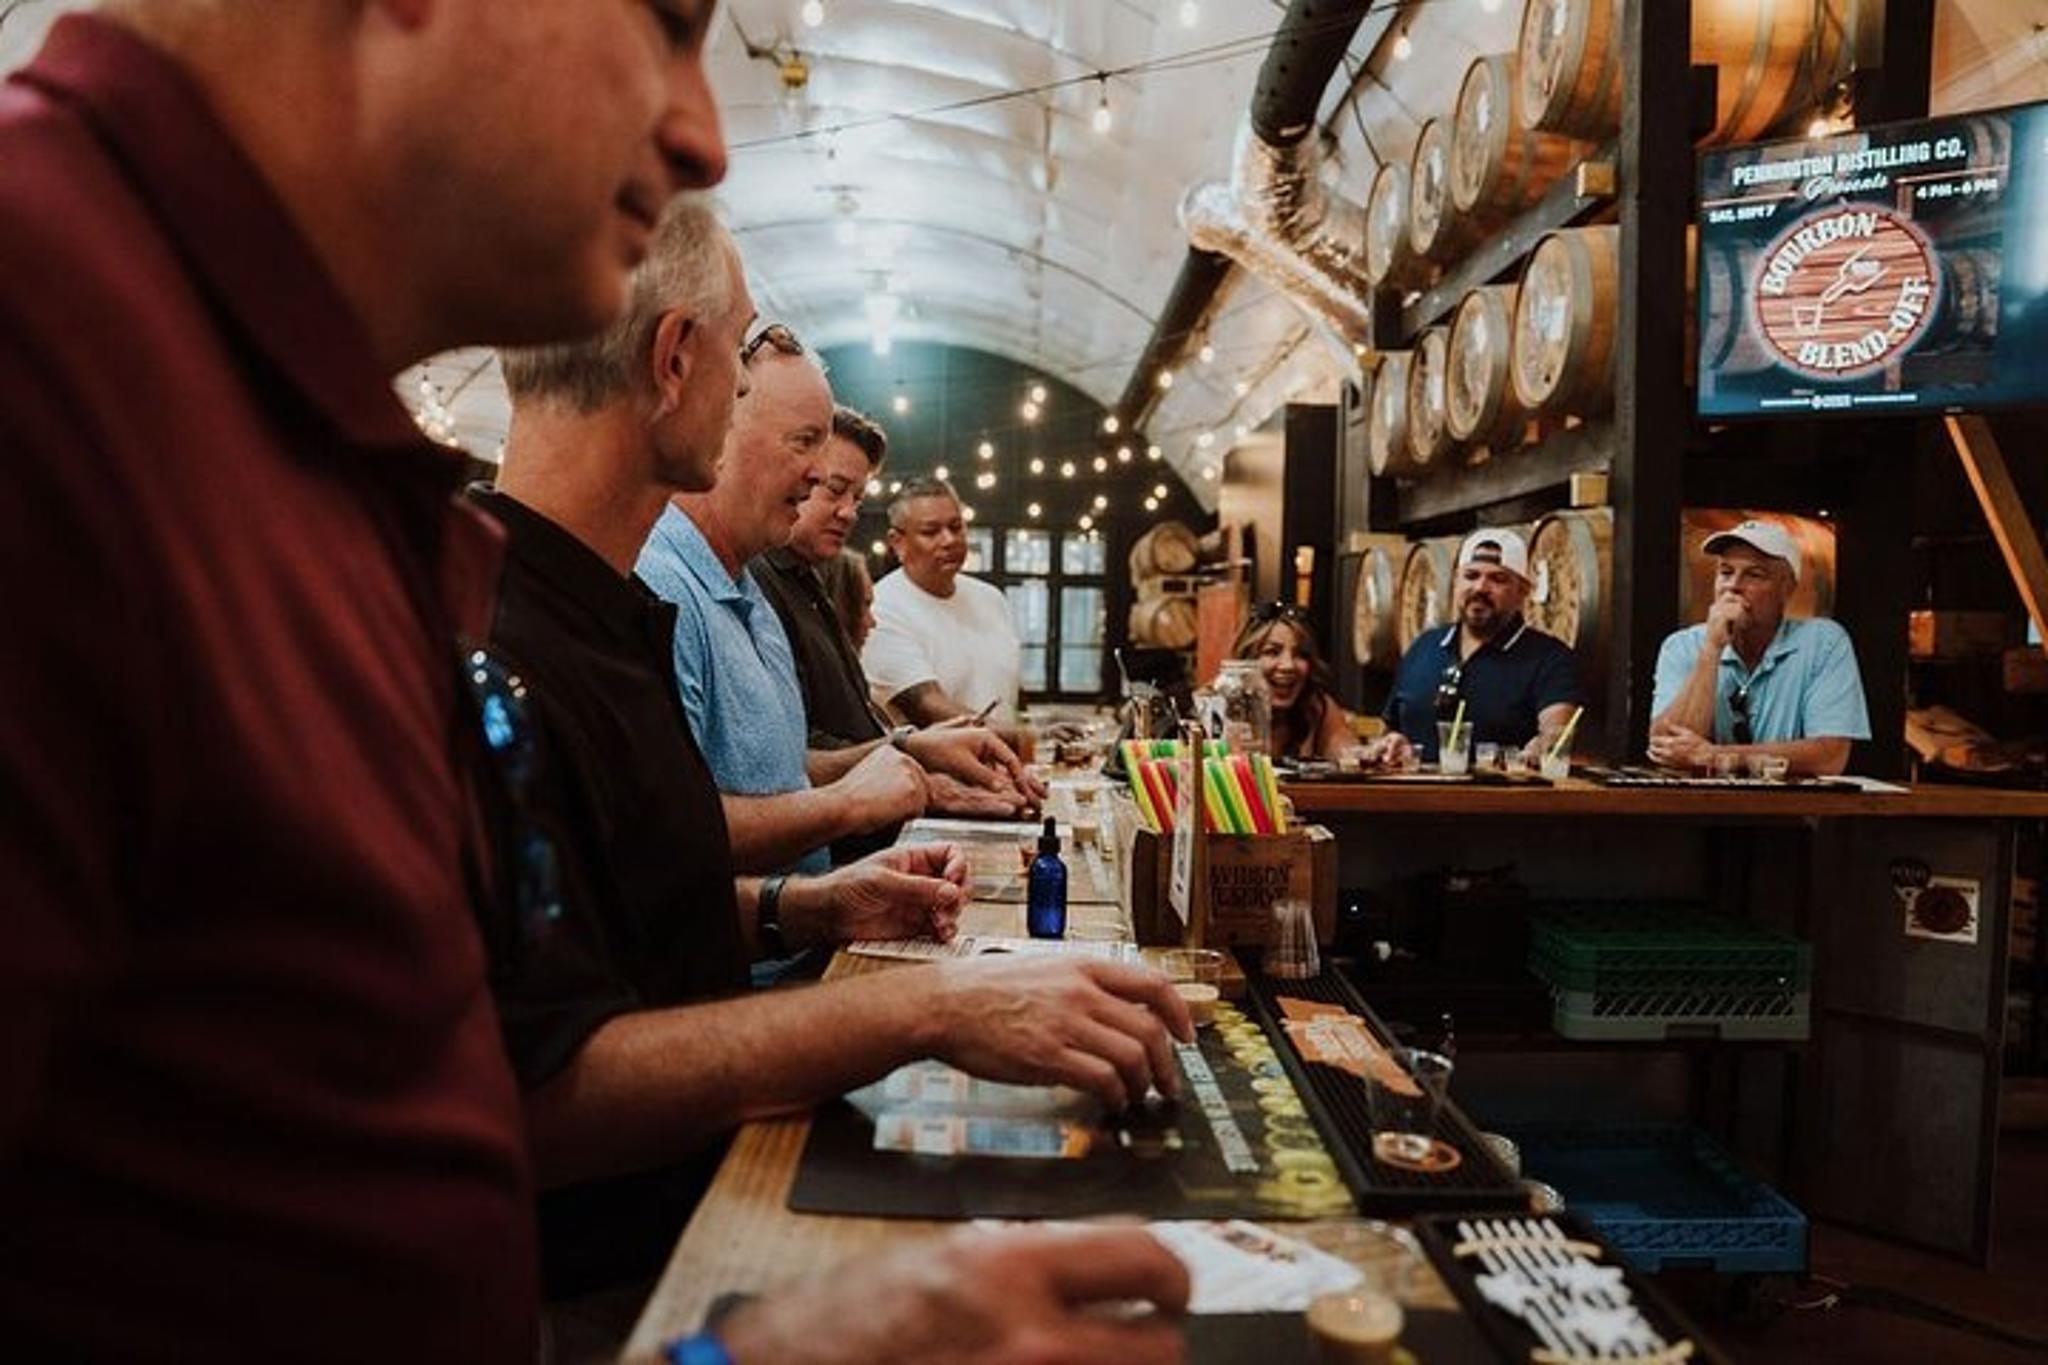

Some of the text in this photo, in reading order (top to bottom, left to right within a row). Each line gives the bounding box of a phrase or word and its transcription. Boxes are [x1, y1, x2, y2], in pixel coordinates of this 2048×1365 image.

[1837, 141, 1930, 172] DISTILLING
[1934, 138, 1966, 160] CO.
[1916, 186, 1926, 199] 4
[1930, 183, 1952, 198] PM
[1974, 178, 1998, 192] PM
[1760, 212, 1879, 296] BOURBON
